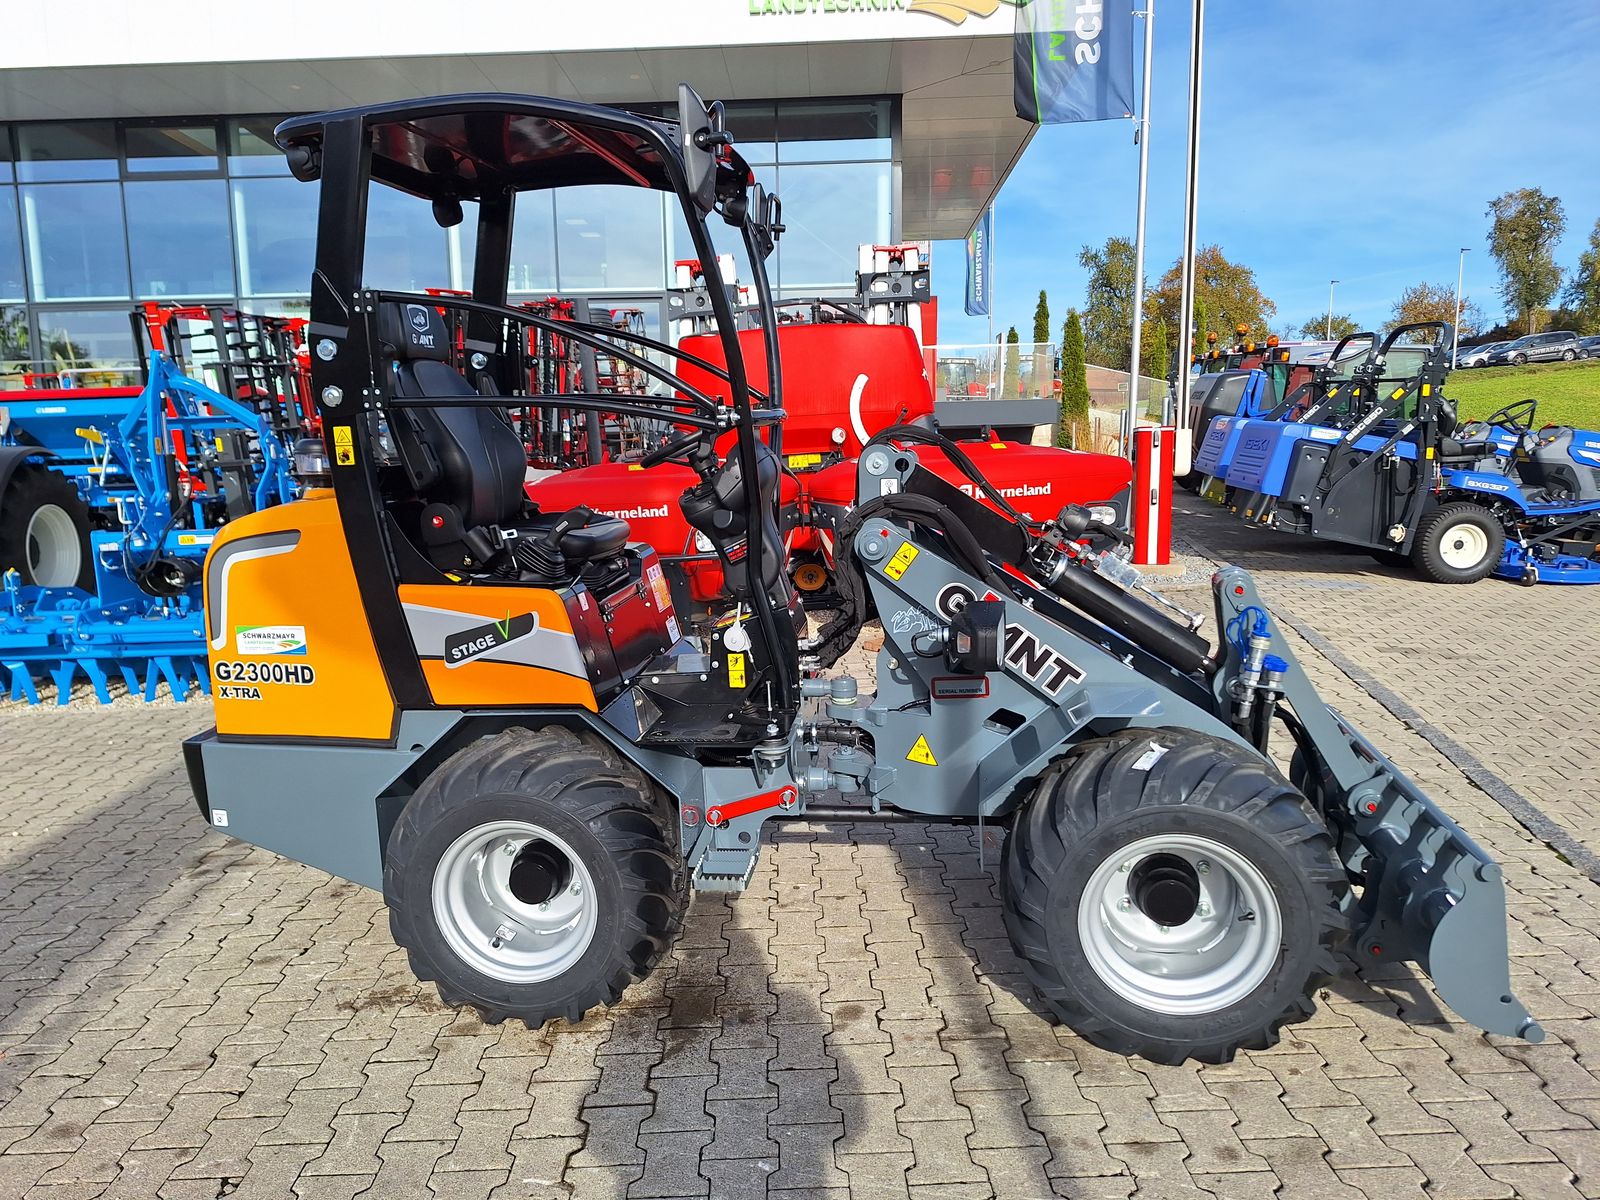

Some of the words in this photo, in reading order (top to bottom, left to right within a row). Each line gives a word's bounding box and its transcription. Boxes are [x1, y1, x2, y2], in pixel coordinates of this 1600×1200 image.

[411, 333, 434, 346] GANT
[242, 632, 296, 640] SCHWARZMAYR
[936, 583, 1087, 697] GANT
[451, 634, 496, 659] STAGE
[214, 661, 315, 685] G2300HD
[219, 686, 261, 699] X-TRA
